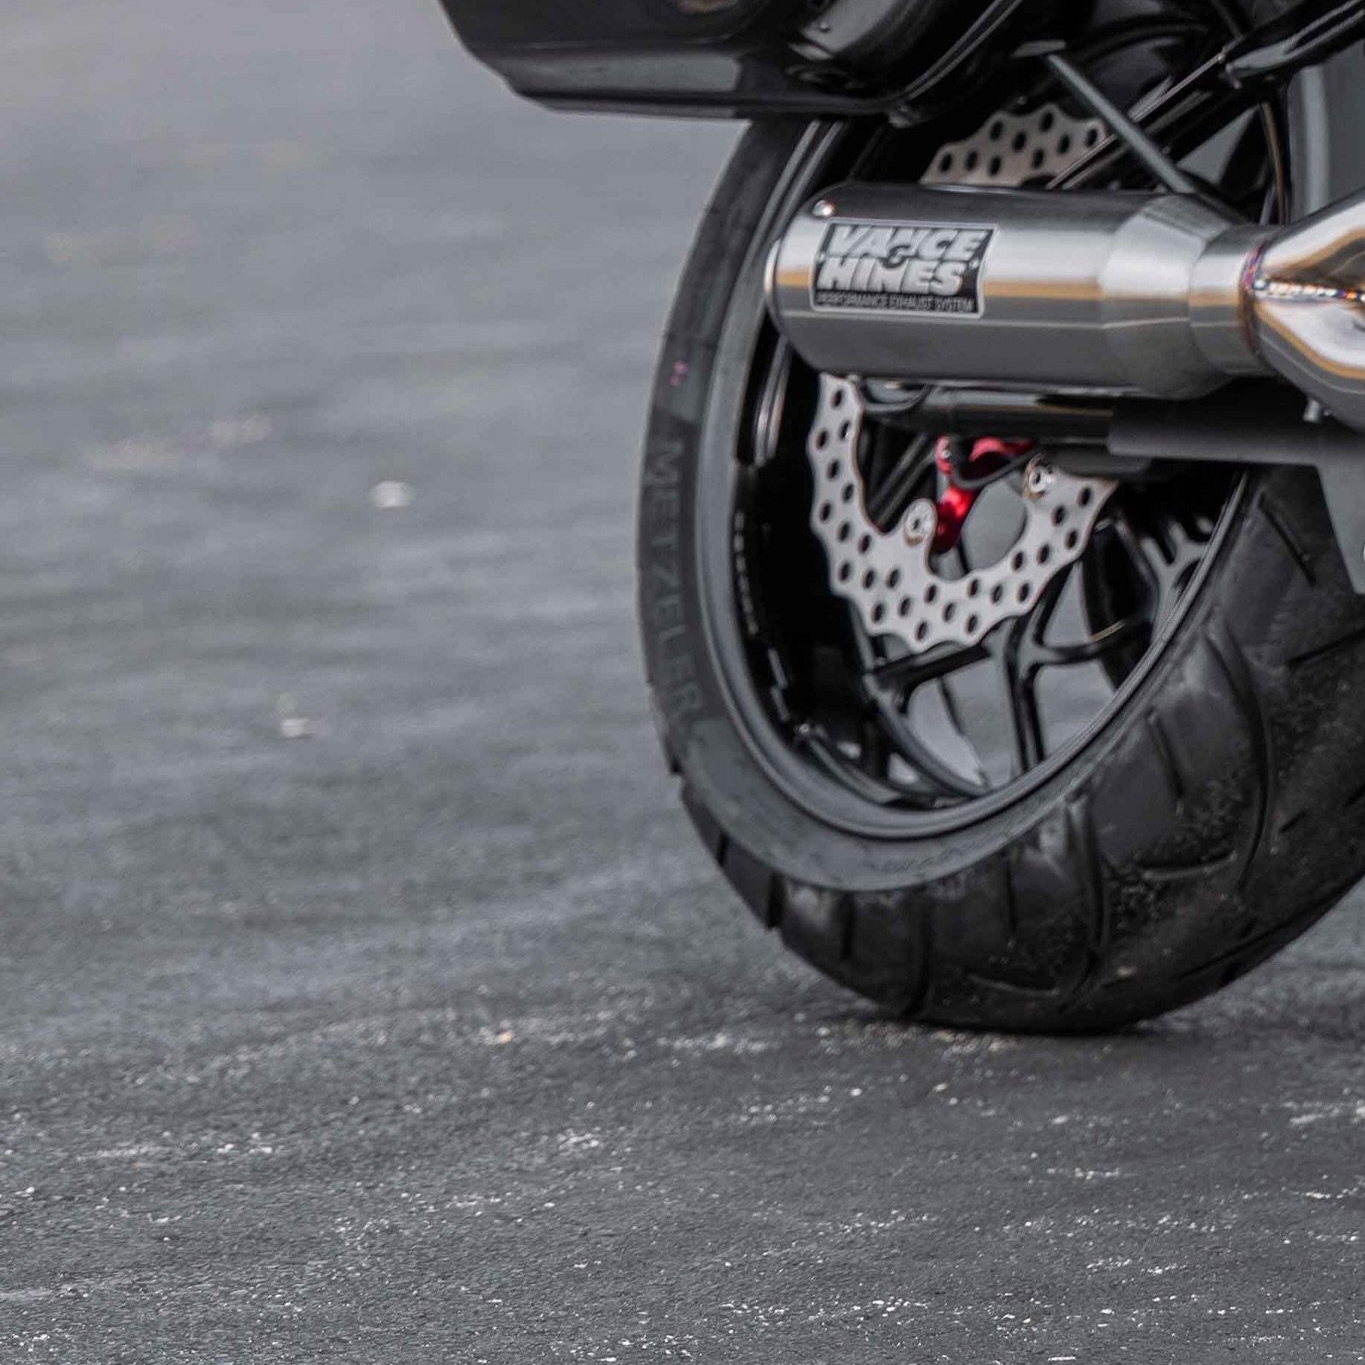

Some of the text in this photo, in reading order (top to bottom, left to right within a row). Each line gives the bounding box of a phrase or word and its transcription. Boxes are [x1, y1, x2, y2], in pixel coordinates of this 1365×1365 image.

[827, 225, 989, 261] VANCE
[816, 256, 966, 296] HINES
[889, 295, 934, 311] EXHAUST
[646, 440, 703, 718] METZELER
